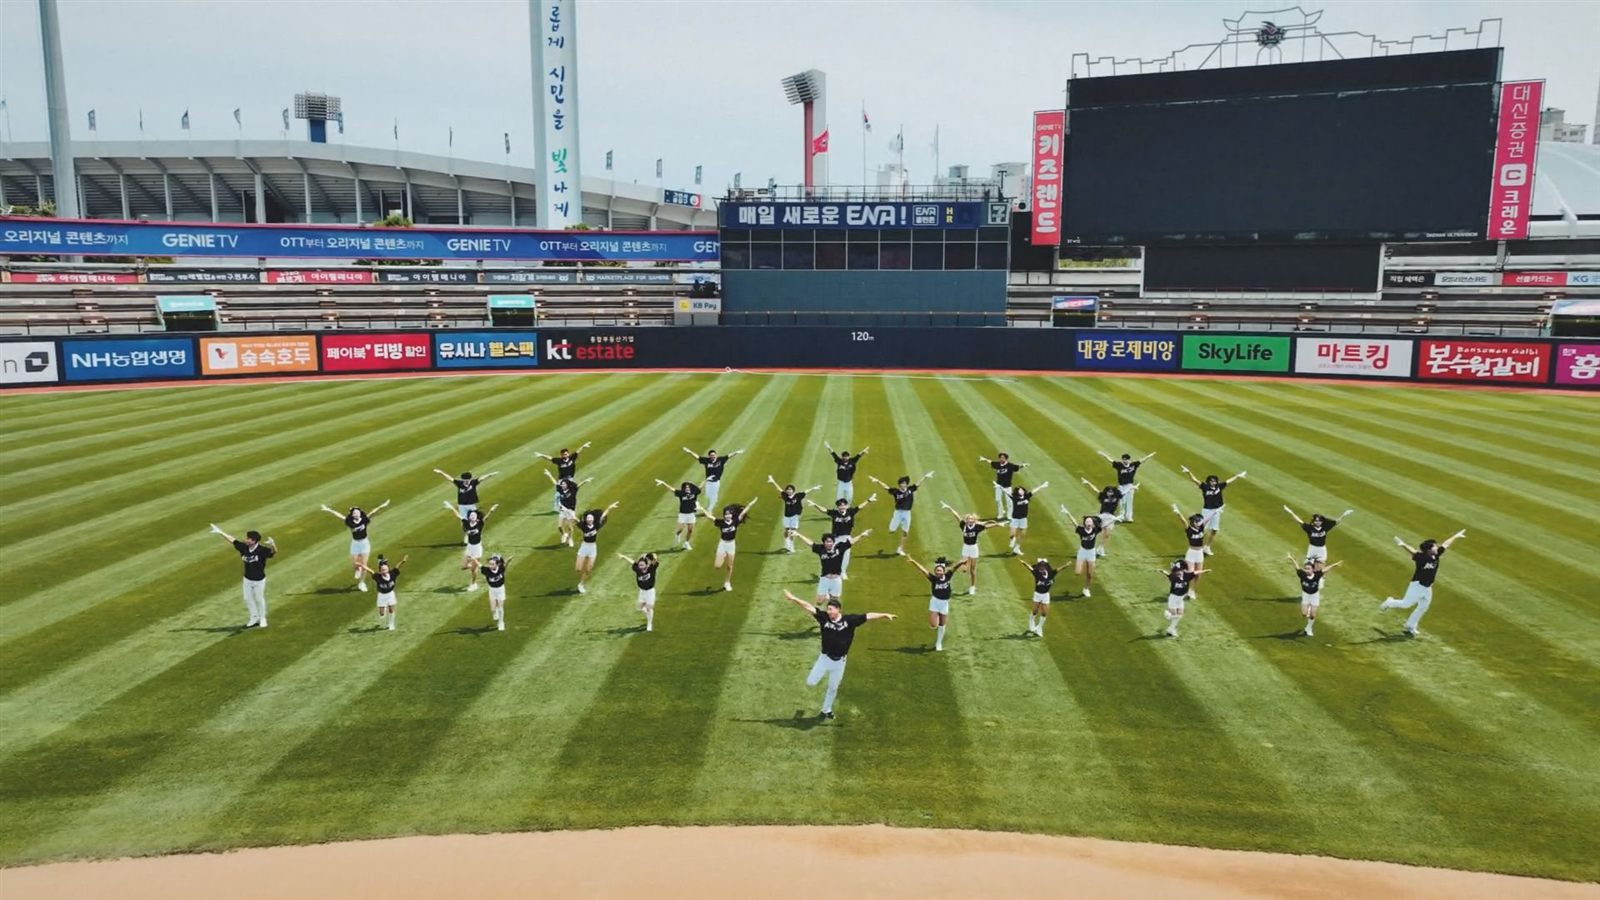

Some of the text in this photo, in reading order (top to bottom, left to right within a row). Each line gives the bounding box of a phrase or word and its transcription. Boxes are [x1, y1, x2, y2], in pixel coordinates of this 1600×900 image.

[549, 65, 566, 131] 시민을
[1507, 85, 1531, 158] 대신증권
[551, 148, 569, 217] 빛나게
[1036, 133, 1060, 233] 키즈랜드
[738, 205, 775, 225] 매일
[782, 205, 840, 225] 새로운
[1499, 190, 1520, 235] 크레온
[4, 230, 129, 246] 오리지널 콘텐츠까지
[162, 233, 239, 248] GENIE TV
[280, 236, 425, 250] OTT부터 오리지널 콘텐츠까지
[446, 238, 512, 252] GENIE TV
[539, 240, 667, 253] OTT부터 오리지널 콘텐츠까지
[1572, 275, 1589, 283] KG
[71, 349, 186, 368] NH농협생명
[240, 347, 311, 367] 숲속호두
[326, 343, 426, 360] 페이북 티빙 할인
[439, 341, 535, 358] 유사나 헬스팩
[546, 339, 634, 360] kt estate
[1077, 340, 1175, 361] 대광 로제비앙
[1198, 343, 1273, 363] SkyLife
[1317, 343, 1389, 369] 마트킹
[1426, 343, 1540, 377] 본수원갈비
[1569, 353, 1600, 379] 홈
